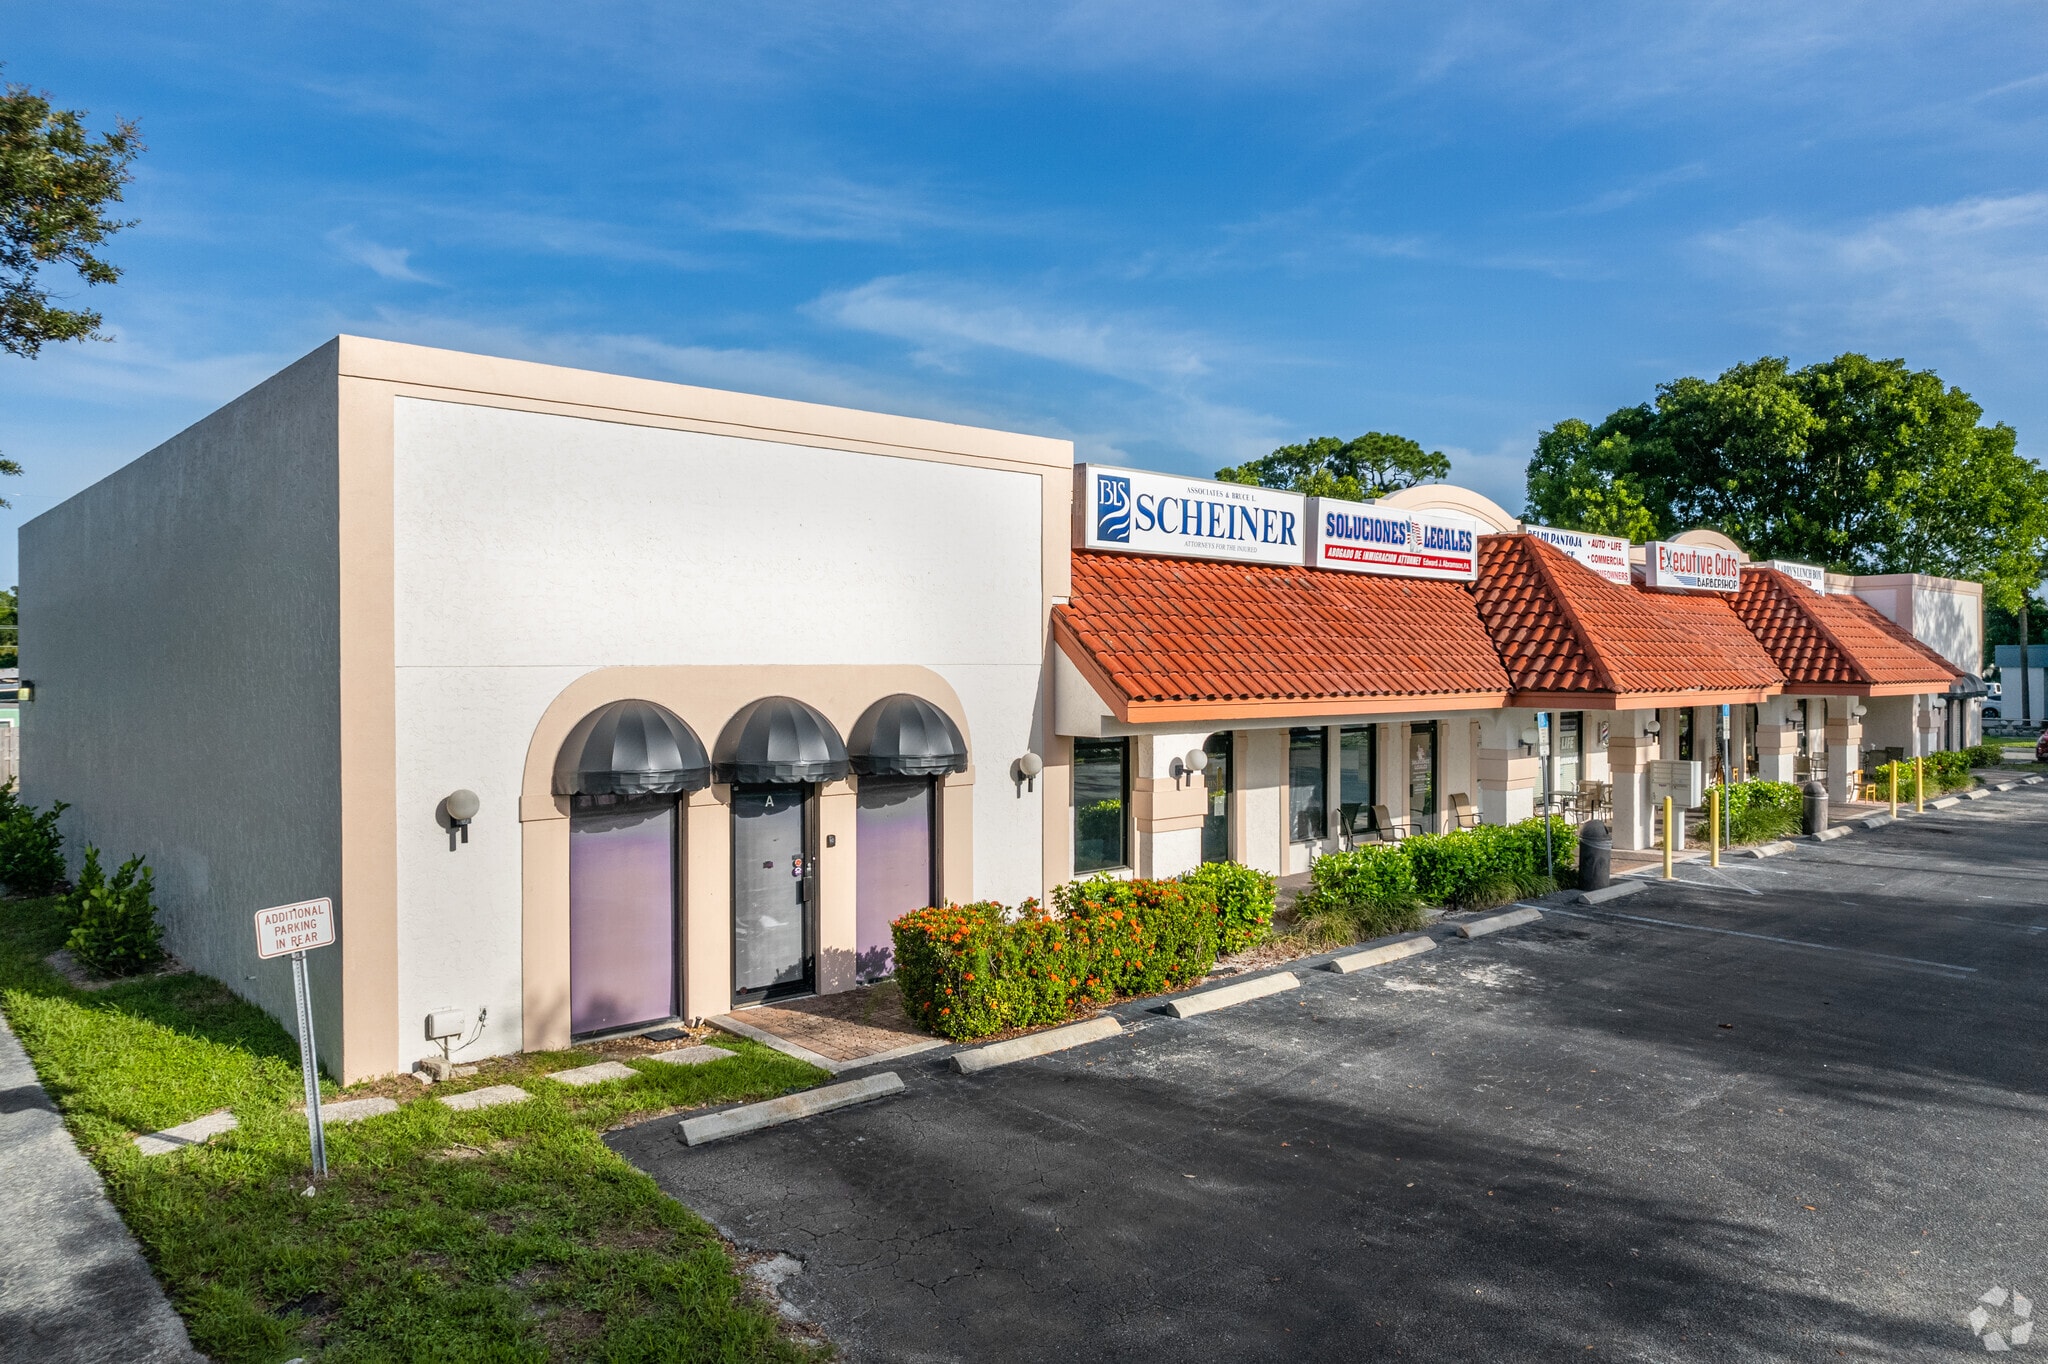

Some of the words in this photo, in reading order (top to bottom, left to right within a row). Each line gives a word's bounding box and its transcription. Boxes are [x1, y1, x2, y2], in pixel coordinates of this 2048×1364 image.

[1187, 487, 1223, 498] ASSOCIATES
[1225, 491, 1230, 499] &
[1231, 492, 1250, 500] BRUCE
[1135, 493, 1297, 546] SCHEINER
[1326, 512, 1406, 545] SOLUCIONES
[1424, 526, 1472, 552] LEGALES
[1184, 540, 1215, 549] ATTORNEYS
[1237, 545, 1258, 553] INJURED
[1550, 533, 1582, 548] PANTOJA
[1591, 539, 1606, 549] AUTO
[1610, 541, 1622, 552] LIFE
[1327, 547, 1354, 559] ABOGADO
[1354, 549, 1362, 560] DE
[1397, 554, 1422, 566] ATTORNEY
[1590, 554, 1625, 566] COMMERCIAL
[1715, 552, 1737, 577] Cuts
[1696, 577, 1738, 590] BARBERSHOP
[765, 795, 774, 807] A
[265, 905, 324, 925] ADDITIONAL
[275, 919, 316, 936] PARKING
[276, 938, 286, 950] IN
[291, 932, 317, 946] REAR
